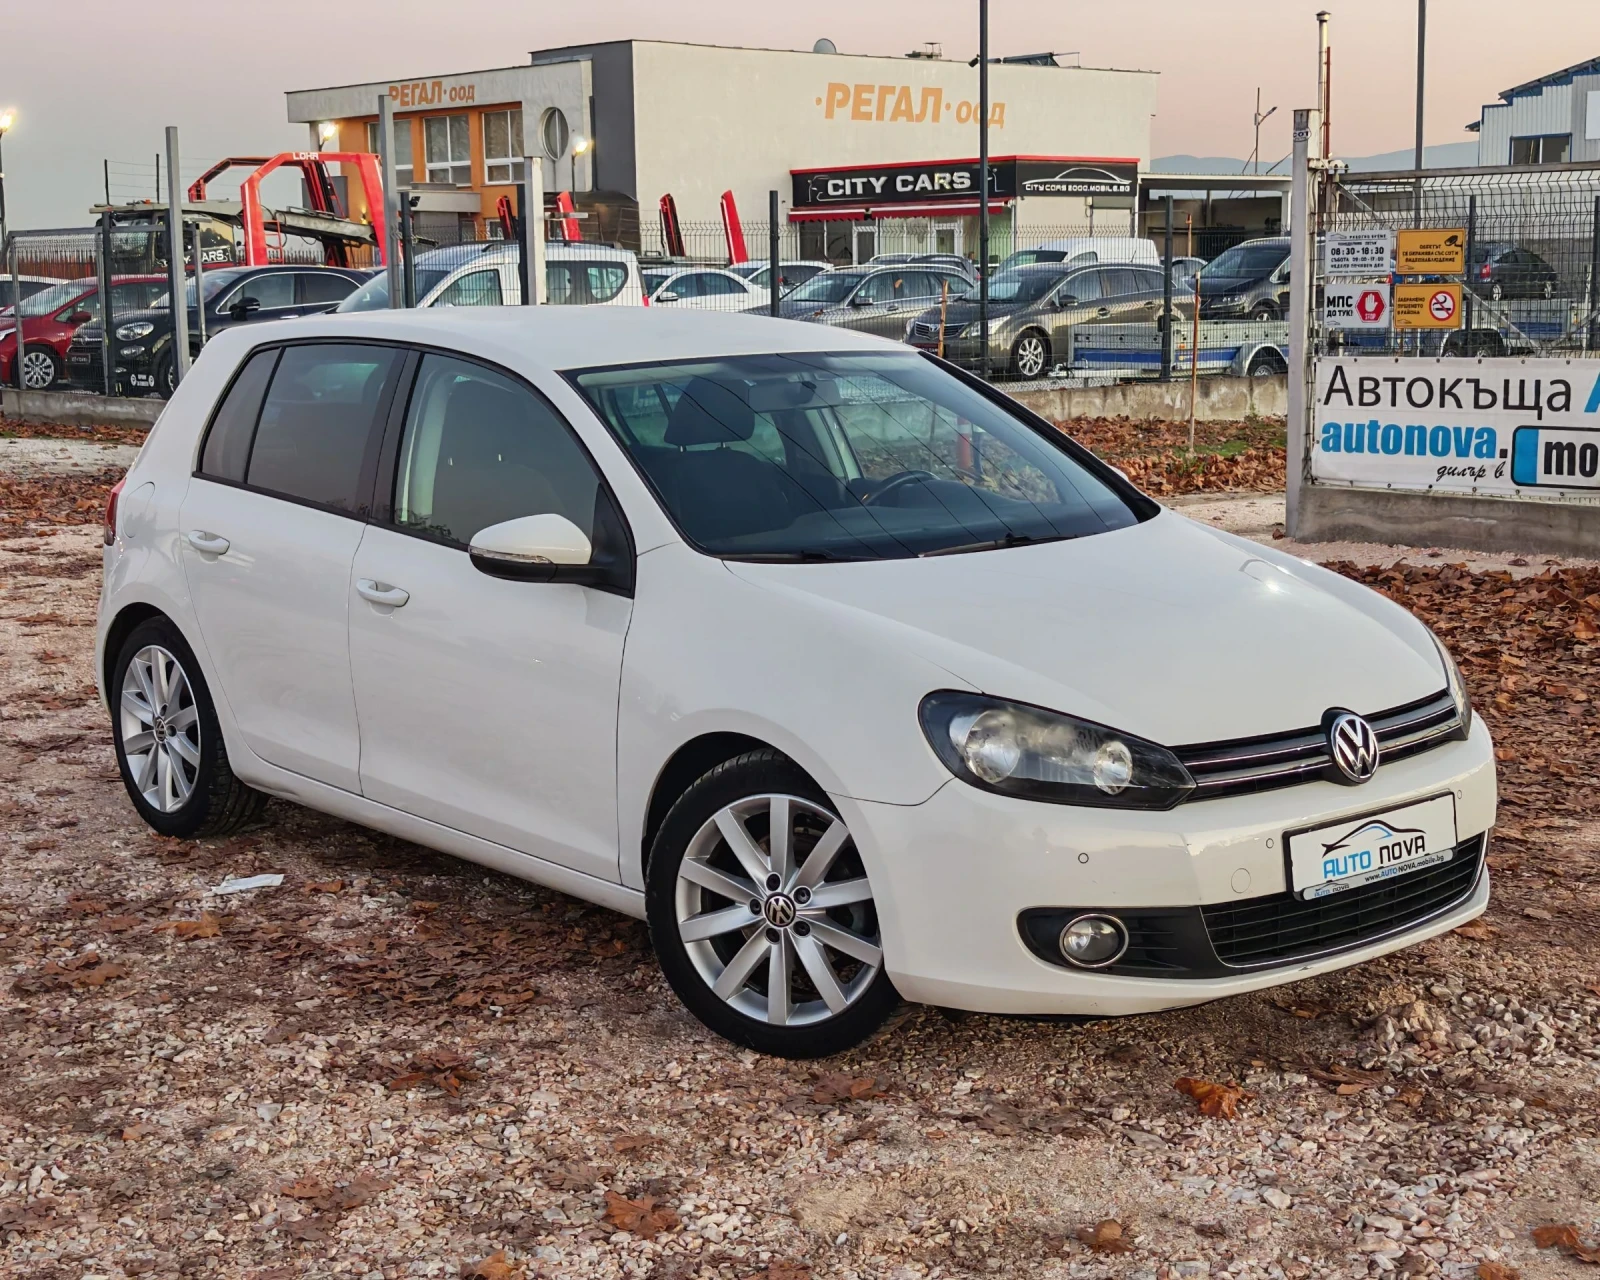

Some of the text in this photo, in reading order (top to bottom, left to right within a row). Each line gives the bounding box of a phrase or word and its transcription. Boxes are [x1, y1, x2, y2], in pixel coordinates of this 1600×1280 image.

[389, 81, 443, 106] РЕГАЛ
[824, 81, 943, 123] РЕГАЛ
[827, 171, 971, 196] CITY CARS
[1326, 295, 1353, 308] МПС
[1326, 309, 1337, 318] ДО
[1323, 365, 1572, 421] Автокъща
[1323, 835, 1426, 880] AUTO NOVA
